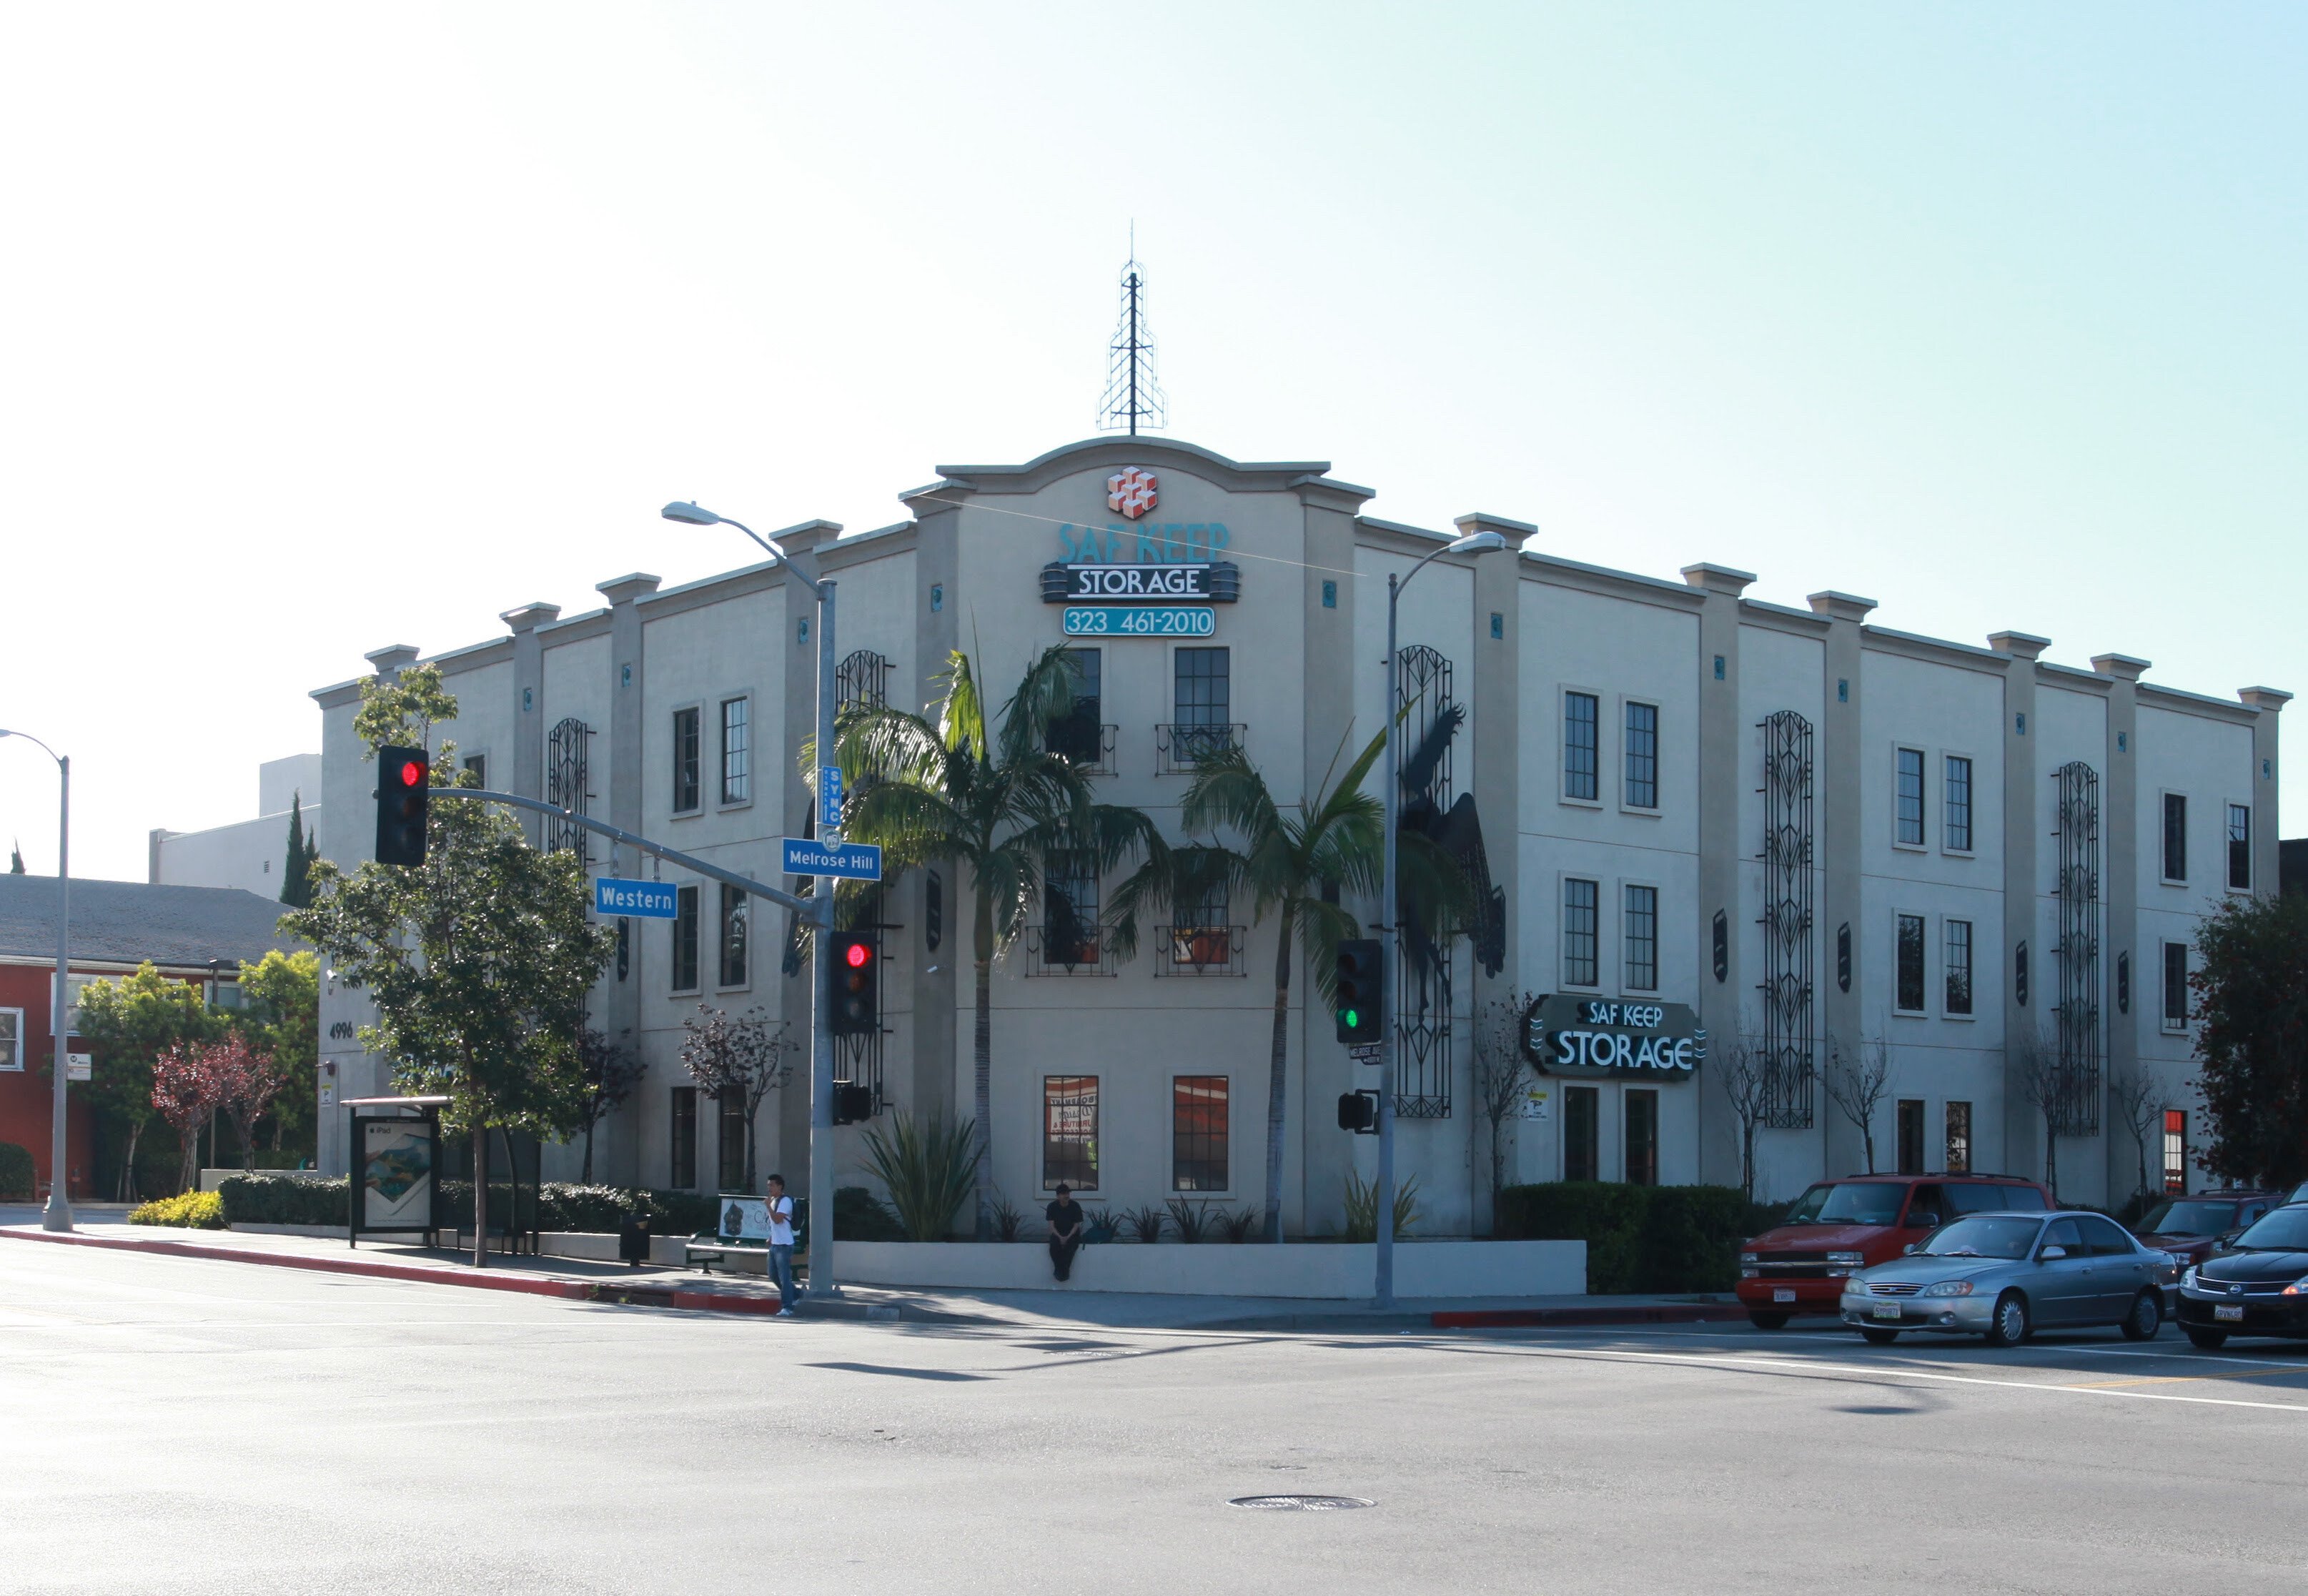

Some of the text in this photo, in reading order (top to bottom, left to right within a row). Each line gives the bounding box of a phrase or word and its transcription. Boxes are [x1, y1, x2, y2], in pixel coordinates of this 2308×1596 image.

[1058, 522, 1230, 563] SAF KEEP
[1079, 570, 1200, 594] STORAGE
[1067, 612, 1212, 633] 323 461-2010
[829, 770, 840, 823] SYNC
[790, 850, 873, 870] Melrose Hill
[601, 886, 672, 909] Western
[1590, 1001, 1663, 1028] SAF KEEP
[330, 1021, 353, 1040] 4996
[1558, 1031, 1693, 1071] STORAGE
